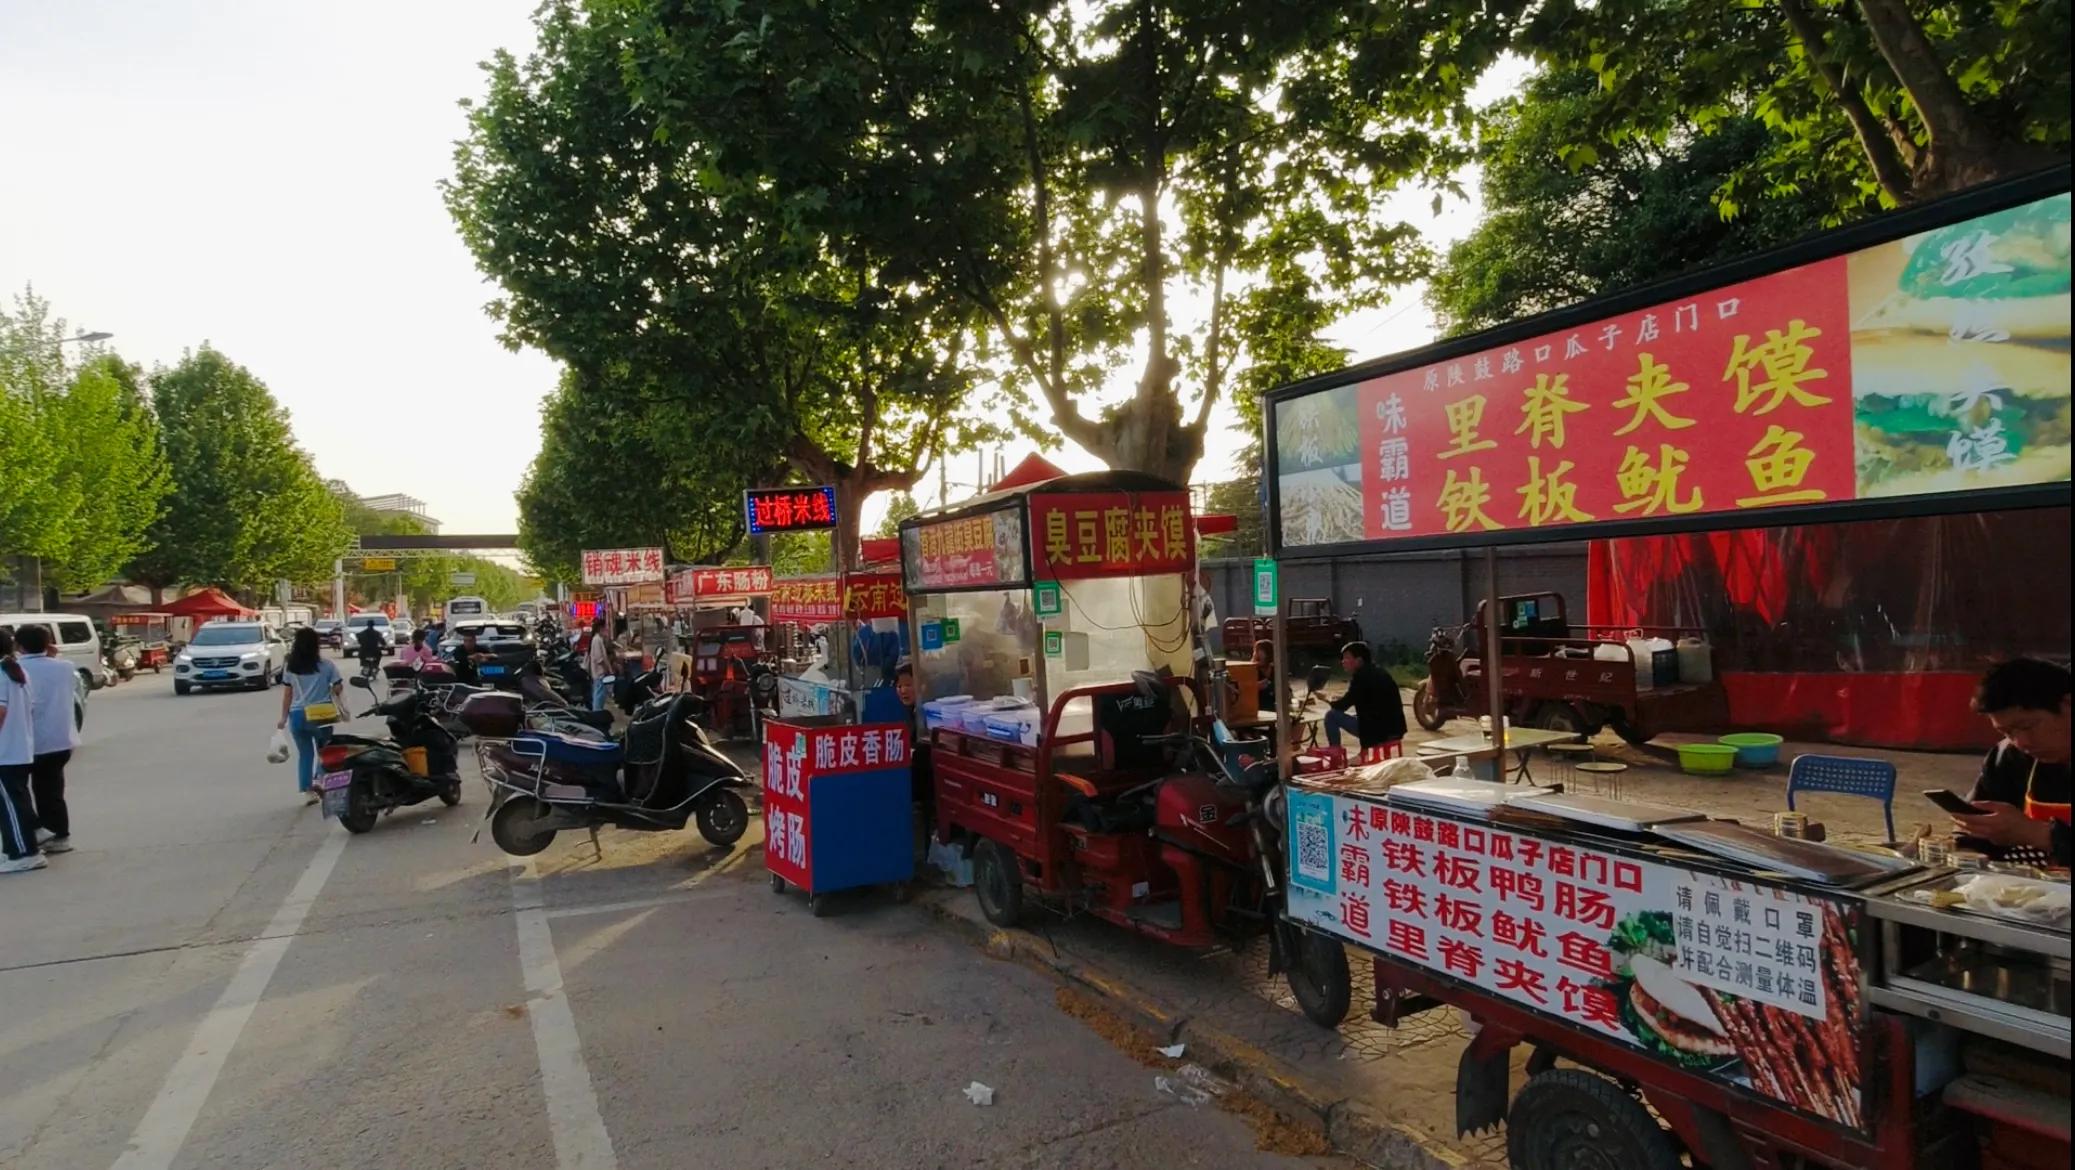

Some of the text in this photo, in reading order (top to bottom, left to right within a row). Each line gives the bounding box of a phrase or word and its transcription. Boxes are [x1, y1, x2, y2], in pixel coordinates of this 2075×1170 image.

[1422, 297, 1743, 392] 原陕鼓路口瓜子店门口
[1435, 319, 1833, 461] 里脊夹馍
[754, 491, 830, 528] 过桥米线
[1435, 426, 1828, 534] 铁板鱿鱼
[585, 550, 662, 577] 销魂米线
[1045, 504, 1188, 566] 臭豆腐夹馍
[697, 571, 769, 593] 广东肠粉
[815, 728, 904, 769] 脆皮香肠
[1370, 806, 1644, 894] 原陕鼓路口瓜子店门口
[1383, 839, 1616, 930] 铁板鸭肠
[1676, 885, 1815, 940] 请佩戴口罩
[1383, 879, 1613, 979] 铁板鱿鱼
[1677, 916, 1817, 974] 请自觉扫二维码
[1386, 920, 1623, 1033] 里脊夹馍
[1679, 945, 1817, 1007] 并配合测量体温
